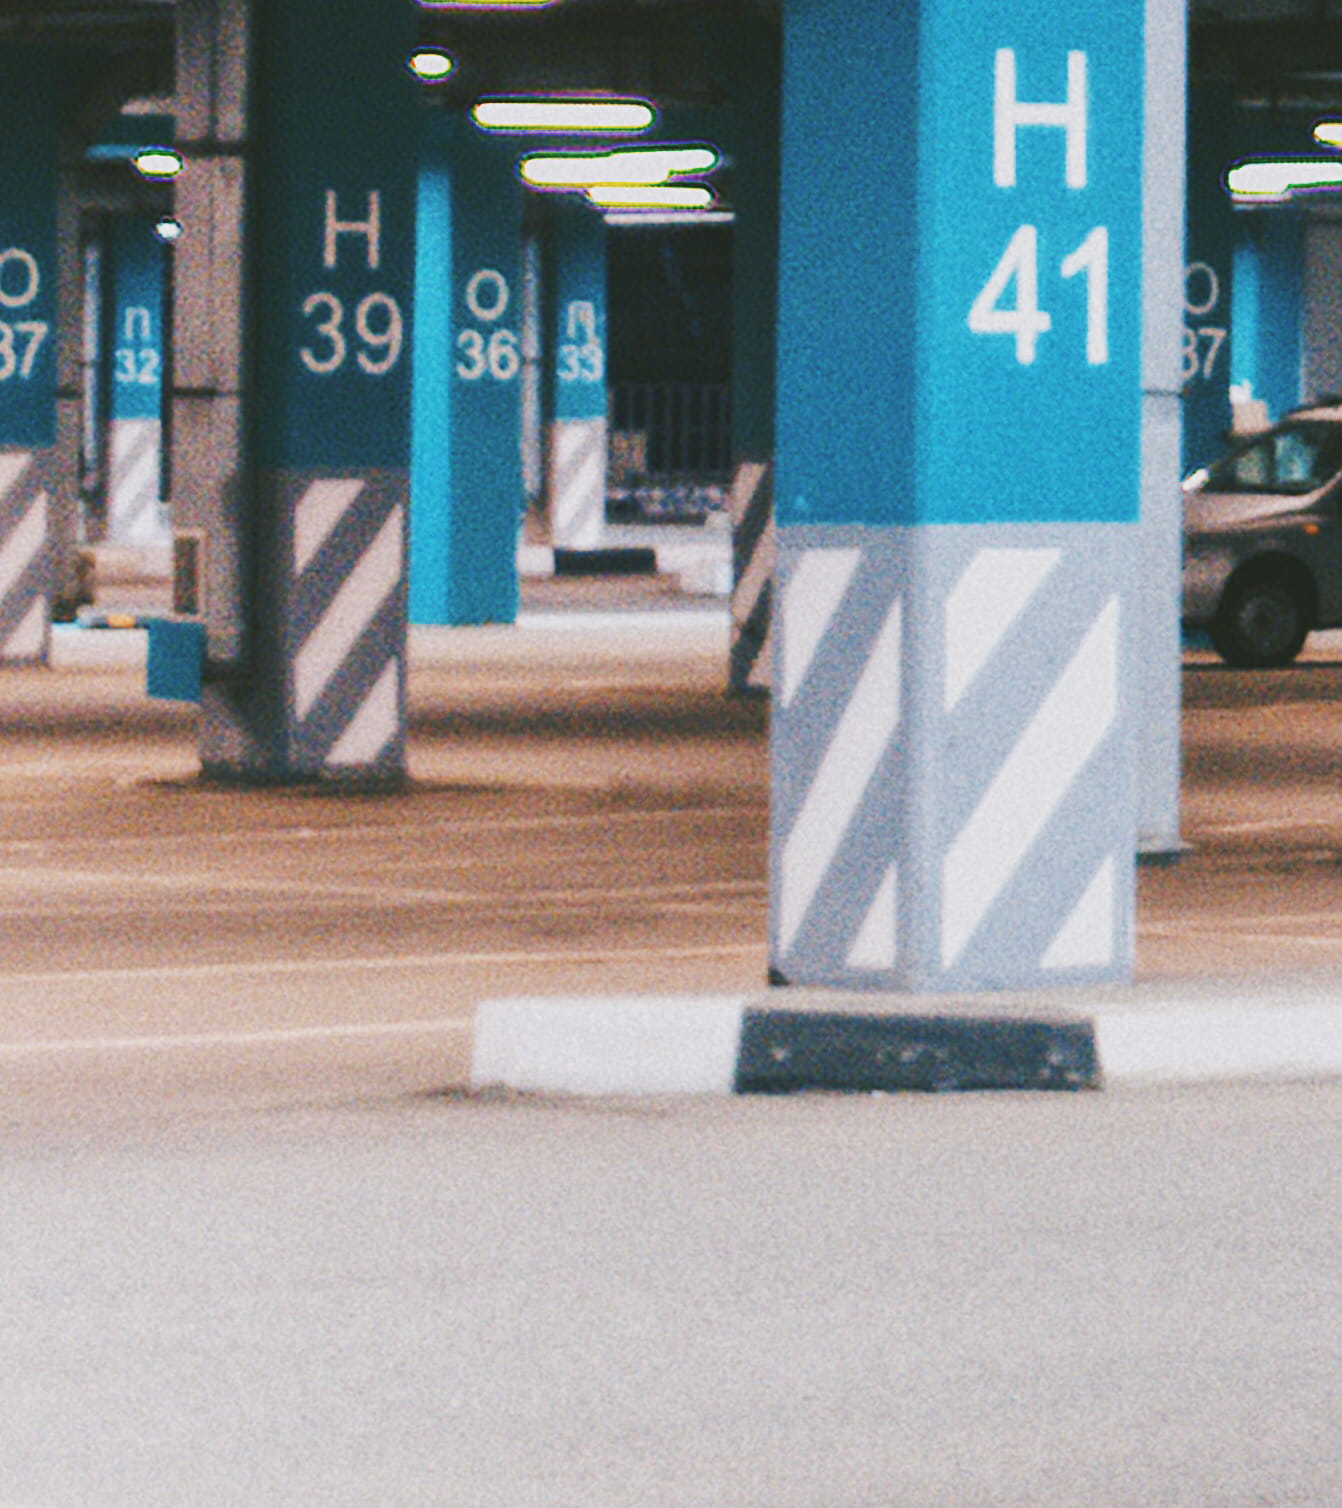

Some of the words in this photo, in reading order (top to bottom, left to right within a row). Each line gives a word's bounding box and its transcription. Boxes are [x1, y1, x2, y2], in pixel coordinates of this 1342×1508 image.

[966, 224, 1109, 365] 41
[115, 348, 160, 383] 32
[301, 291, 402, 375] 39
[457, 330, 520, 380] 36
